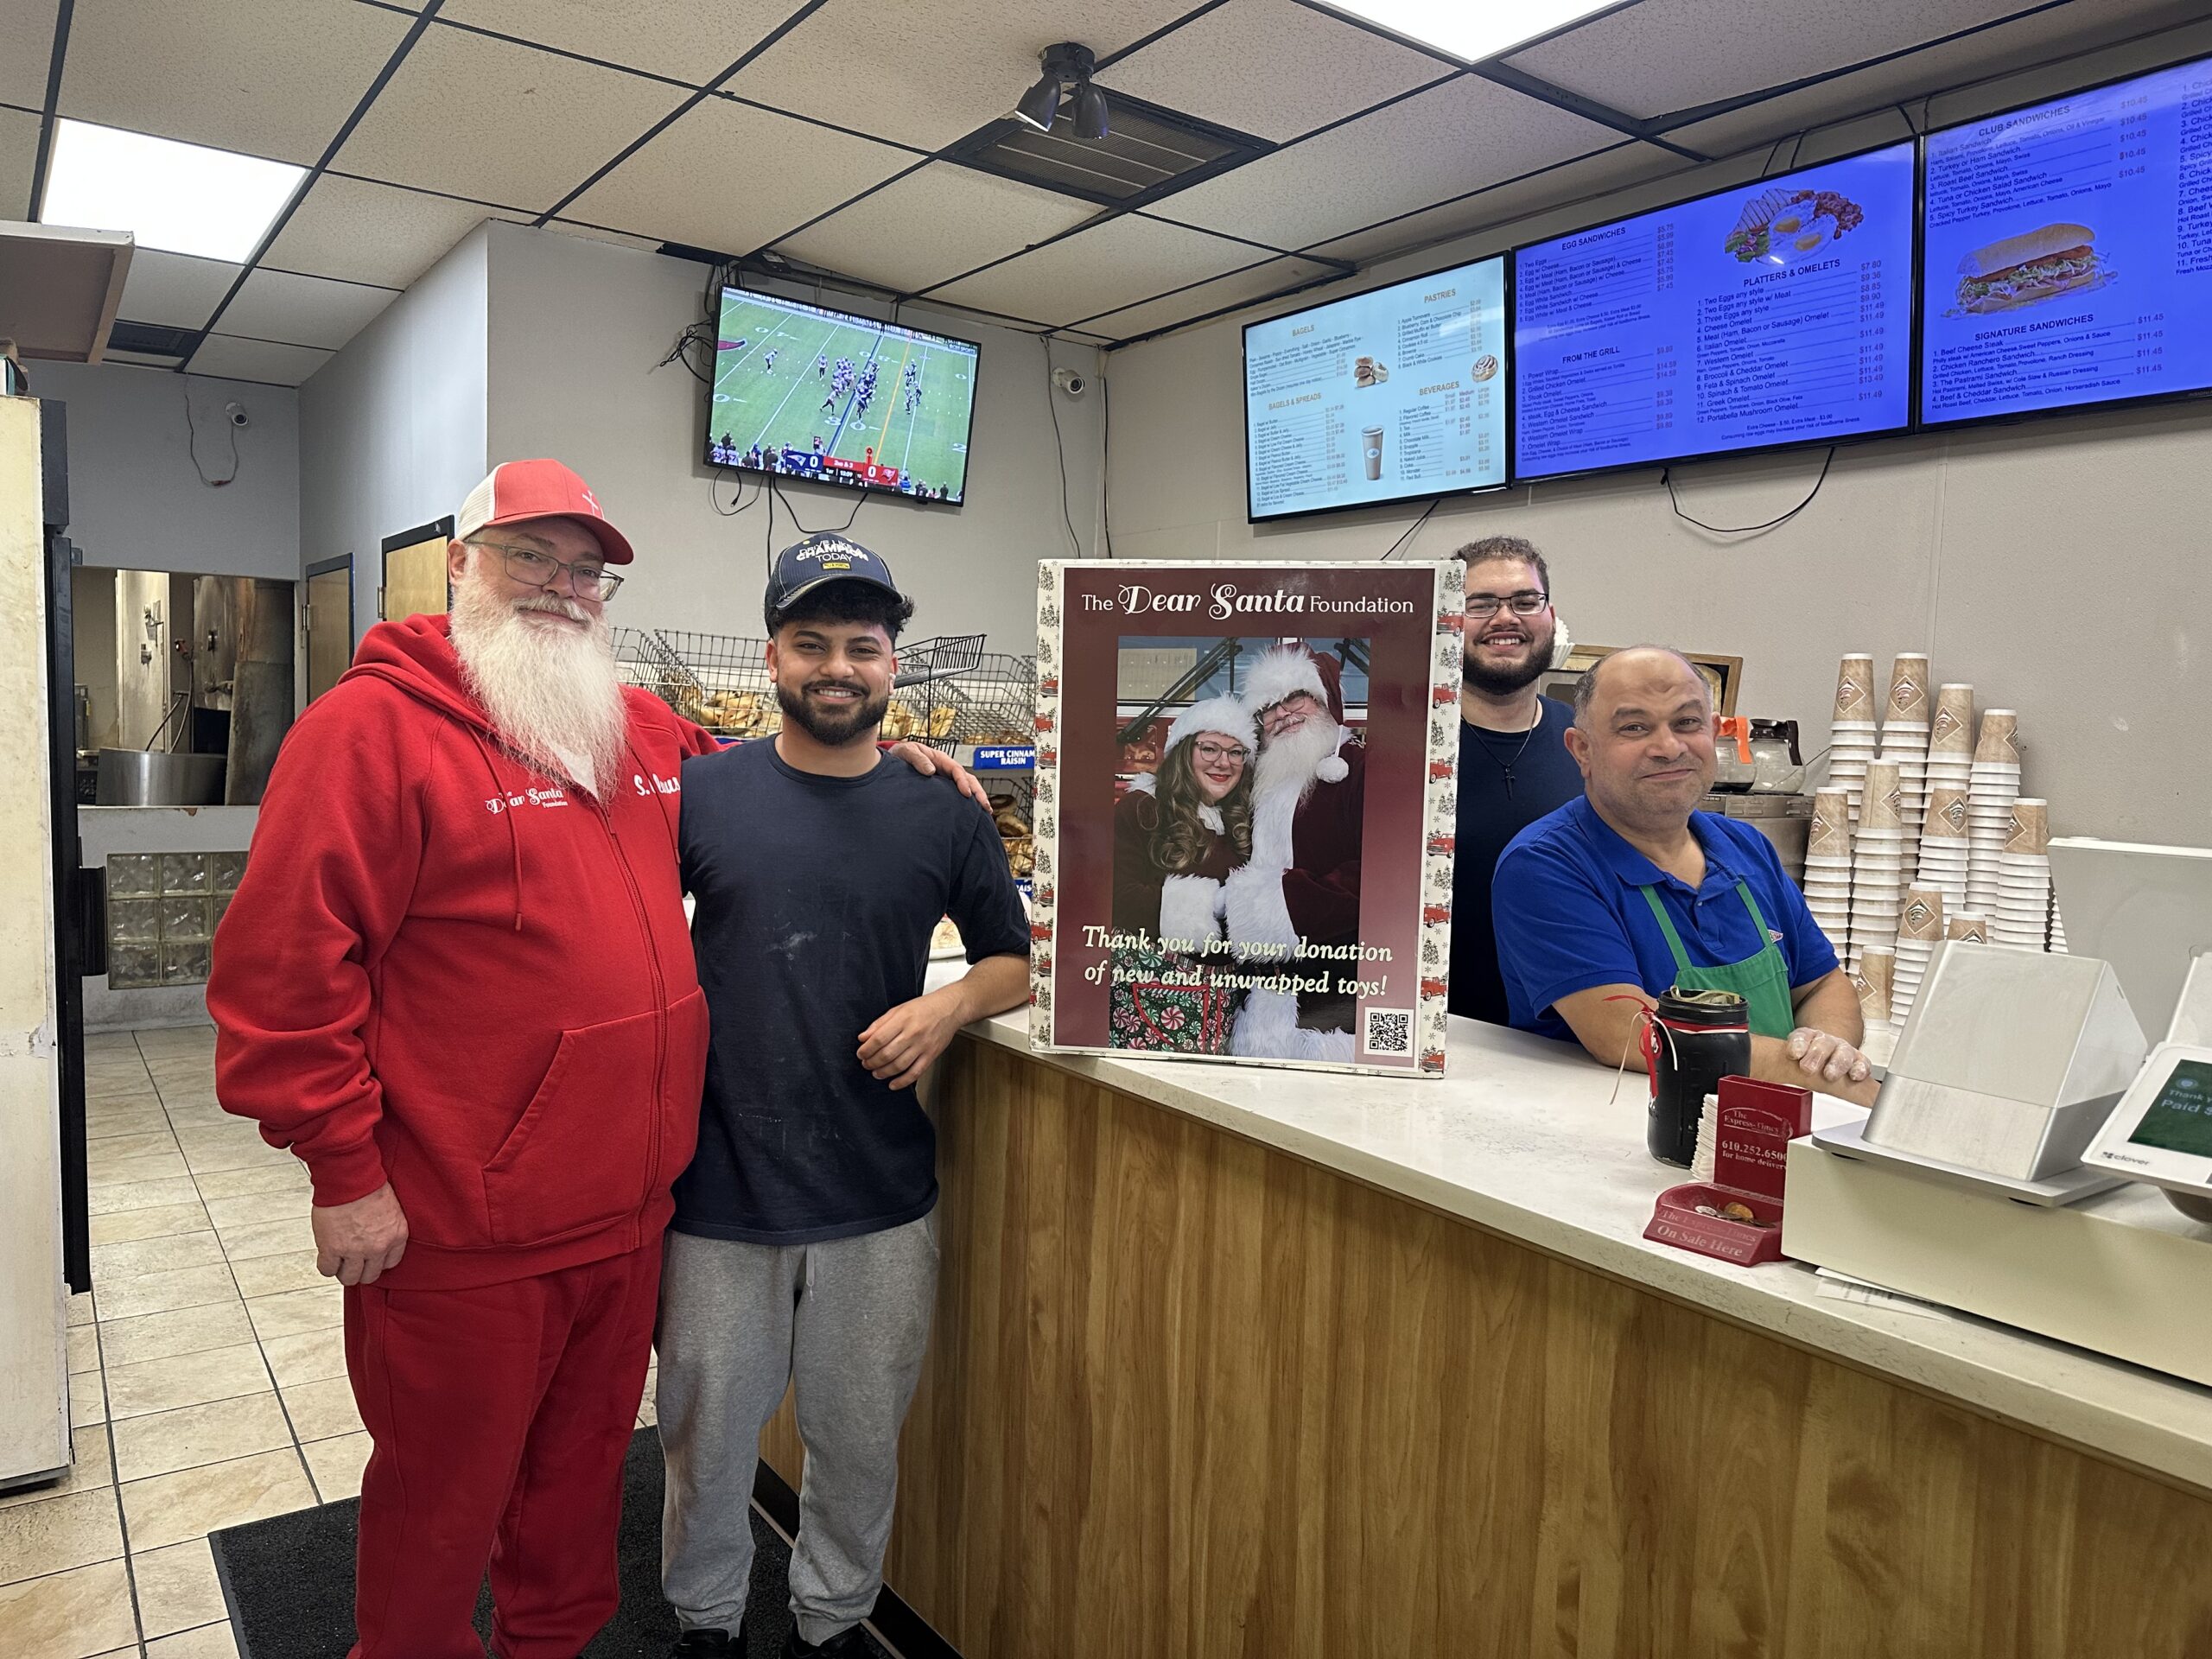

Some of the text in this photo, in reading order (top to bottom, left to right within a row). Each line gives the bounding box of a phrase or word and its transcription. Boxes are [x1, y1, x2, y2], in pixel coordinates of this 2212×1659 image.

[1979, 105, 2069, 136] CLUB SANDWICHES
[1938, 129, 2145, 188] Roast Beef Sandwich $10.45
[1939, 162, 1959, 171] Turkey
[1970, 156, 1986, 164] Ham
[1988, 146, 2020, 159] Sandwich
[1964, 186, 1990, 197] Chicken
[1992, 180, 2011, 190] Salad
[2013, 172, 2046, 185] Sandwich
[2120, 147, 2145, 160] $10.45
[1957, 205, 1977, 214] Turkey
[1980, 196, 2012, 209] Sandwich
[2119, 165, 2145, 178] $10.45
[1562, 226, 1625, 250] EGG SANDWICHES
[1744, 270, 1786, 287] PLATTERS
[1797, 258, 1840, 275] OMELETS
[1424, 288, 1455, 303] PASTRIES
[1718, 294, 1733, 302] Eggs
[1749, 287, 1764, 296] style
[1718, 303, 1733, 312] Eggs
[1749, 296, 1763, 305] style
[1774, 290, 1790, 299] Meat
[1724, 311, 1739, 320] Eggs
[1741, 325, 1761, 334] Bacon
[1804, 311, 1828, 321] Omelet
[1292, 324, 1313, 336] BAGELS
[1704, 317, 1751, 332] Cheese Omelet
[1975, 314, 2093, 340] SIGNATURE SANDWICHES
[1724, 336, 1746, 346] Omelet
[1941, 313, 2163, 355] Beef Cheese Steak $11.45
[1562, 346, 1619, 363] FROM THE GRILL
[1731, 351, 1753, 360] Omelet
[1941, 330, 2163, 371] Chicken Ranchero Sandwich $11.45
[1736, 365, 1762, 375] Cheddar
[1764, 360, 1788, 370] Omelet
[1985, 369, 2017, 379] Sandwich
[1726, 376, 1750, 386] Spinach
[1751, 372, 1775, 381] Omelet
[1419, 380, 1459, 396] BEVERAGES
[1707, 388, 1732, 397] Spinach
[1764, 378, 1788, 388] Omelet
[1963, 389, 1991, 397] Cheddar
[1993, 384, 2025, 394] Sandwich
[1268, 399, 1289, 410] BAGELS
[1295, 392, 1320, 404] SPREADS
[1707, 394, 1749, 406] Greek Omelet
[1774, 402, 1797, 411] Omelet
[810, 456, 818, 467] 0
[868, 467, 876, 478] 0
[816, 553, 853, 562] TODAY
[1081, 583, 1414, 620] The Dear Santa Foundation
[980, 750, 1004, 759] SUPER
[1001, 757, 1027, 766] RAISIN
[633, 774, 651, 796] S.
[525, 787, 564, 805] Santa
[1082, 925, 1393, 962] Thank you for your donation
[1084, 960, 1387, 1000] of new and unwrapped toys!
[2170, 1090, 2203, 1101] Thank
[2162, 1099, 2202, 1113] Paid
[1733, 1109, 1747, 1120] The
[1724, 1115, 1779, 1133] Express-Times
[1722, 1149, 1734, 1160] for
[1735, 1153, 1756, 1163] home
[2113, 1154, 2151, 1166] clover
[1662, 1210, 1681, 1223] The
[1657, 1224, 1743, 1256] On Sale Here
